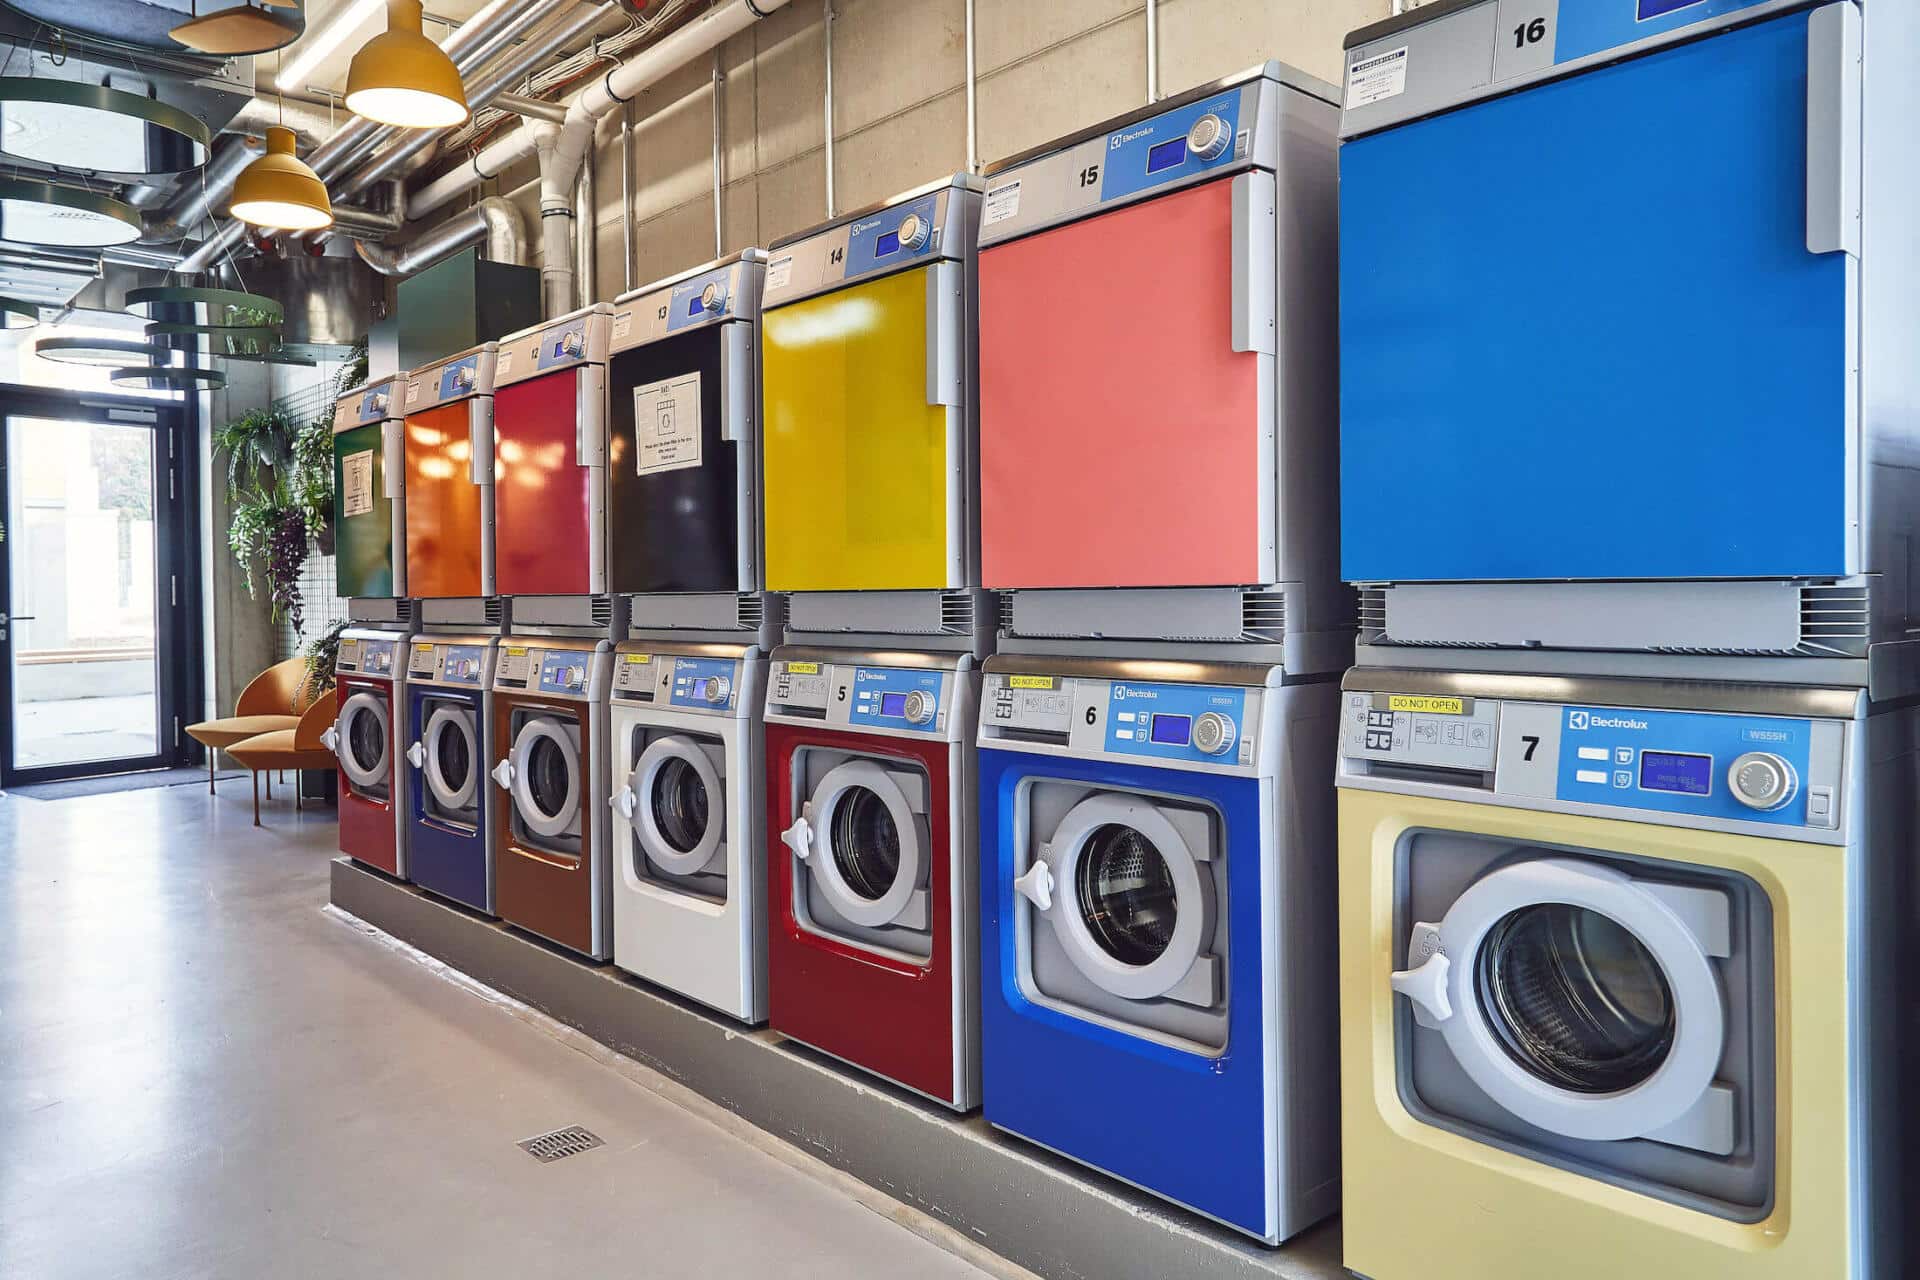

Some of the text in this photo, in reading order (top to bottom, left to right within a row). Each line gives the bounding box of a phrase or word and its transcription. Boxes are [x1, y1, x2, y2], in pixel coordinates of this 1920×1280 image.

[1513, 17, 1546, 48] 16
[1122, 127, 1154, 143] Electrolux
[1080, 165, 1098, 187] 15
[831, 247, 844, 265] 14
[658, 305, 667, 320] 13
[531, 347, 539, 359] 12
[662, 673, 669, 688] 4
[838, 686, 847, 701] 5
[1126, 689, 1158, 699] Electrolux
[1393, 698, 1459, 711] DO NOT OPEN
[1086, 706, 1097, 725] 6
[1591, 715, 1649, 730] Electrolux
[1522, 735, 1540, 761] 7
